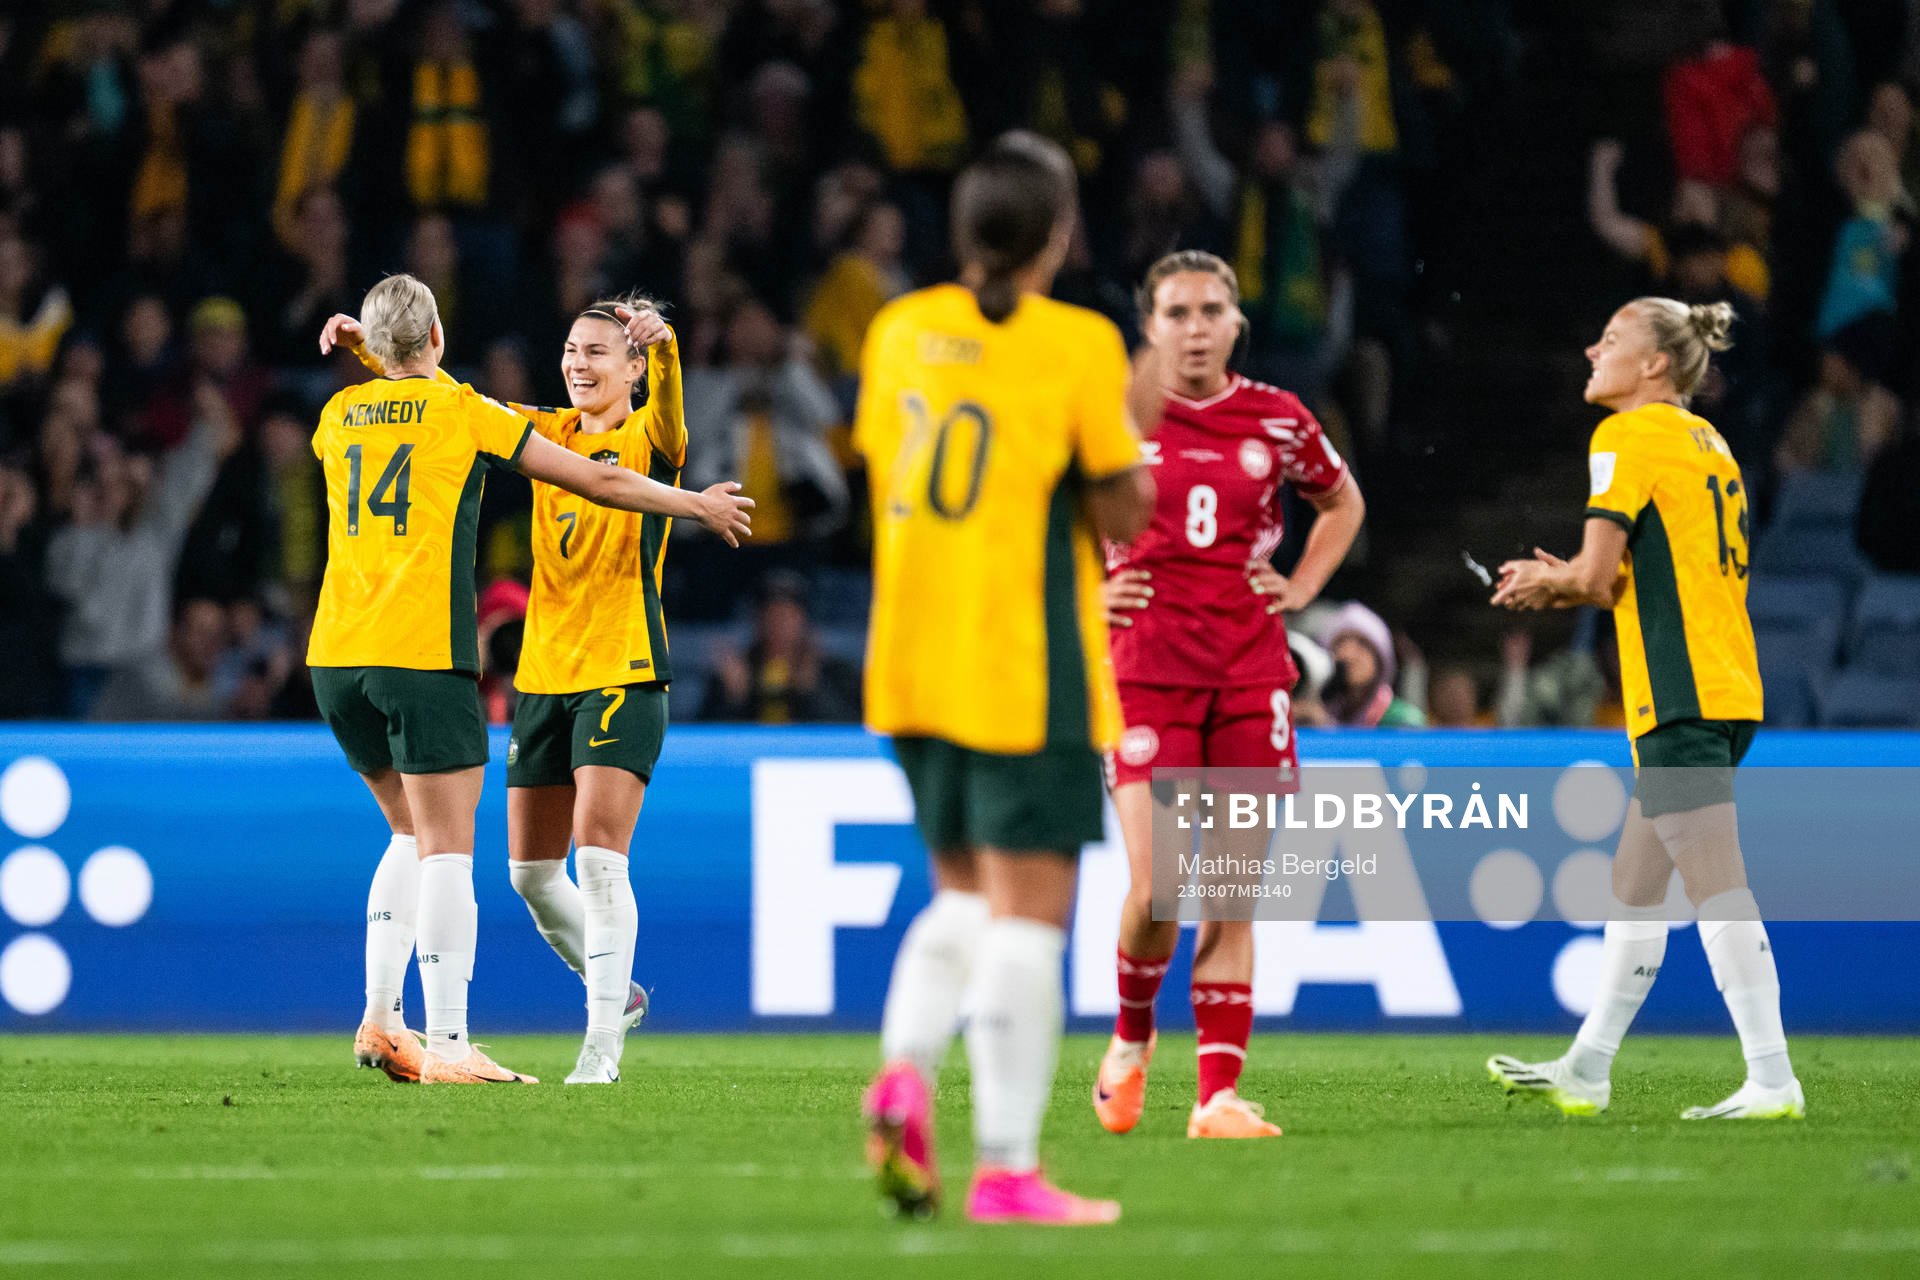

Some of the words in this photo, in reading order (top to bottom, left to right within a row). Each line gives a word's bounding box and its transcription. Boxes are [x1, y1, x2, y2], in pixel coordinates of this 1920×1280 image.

[343, 400, 427, 426] KENNEDY
[343, 443, 416, 536] 14
[1185, 484, 1218, 549] 8
[556, 511, 578, 560] 7
[600, 687, 626, 733] 7
[1269, 687, 1291, 752] 8
